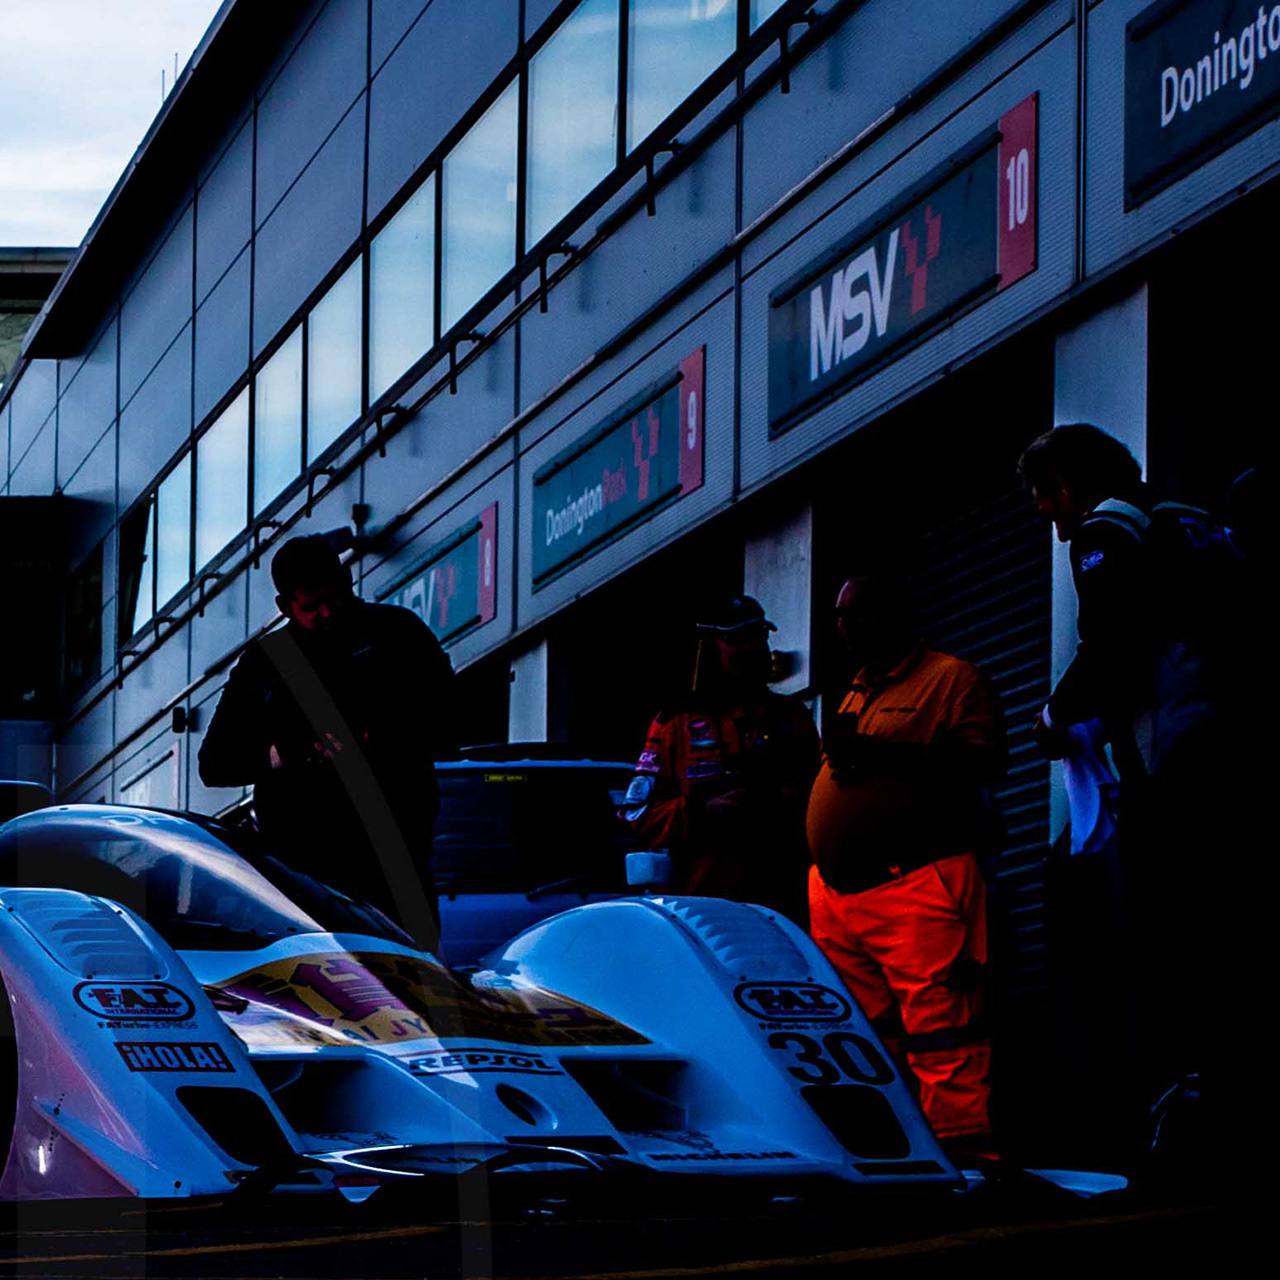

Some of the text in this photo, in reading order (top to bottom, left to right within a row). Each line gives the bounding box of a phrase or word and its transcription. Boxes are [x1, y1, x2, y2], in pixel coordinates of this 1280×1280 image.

[1006, 148, 1030, 232] 10
[809, 226, 902, 382] MSV
[686, 389, 697, 450] 9
[483, 538, 492, 588] 8
[408, 1052, 557, 1070] REPSOL
[767, 1031, 896, 1085] 30
